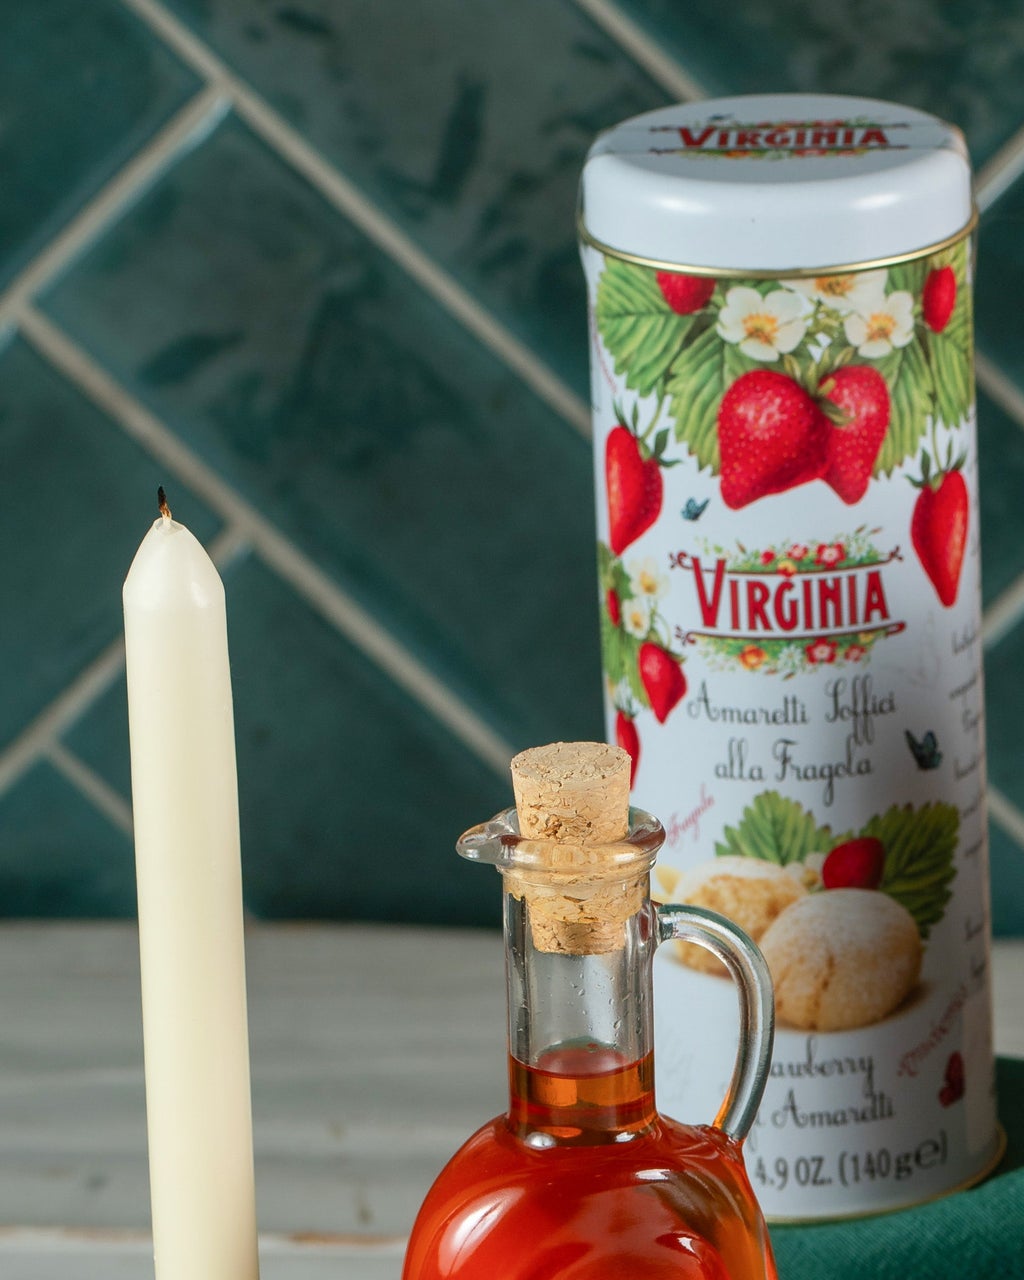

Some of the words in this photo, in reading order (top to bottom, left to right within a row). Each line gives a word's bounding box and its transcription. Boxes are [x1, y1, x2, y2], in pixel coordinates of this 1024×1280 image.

[679, 126, 888, 148] VIRGINIA
[691, 557, 889, 631] VIRGINIA
[687, 680, 809, 726] Amaretti
[824, 674, 898, 746] Soffici
[714, 736, 764, 783] alla
[771, 738, 873, 807] Fragola
[772, 1088, 893, 1129] Amaretti
[754, 1156, 789, 1190] 4.9
